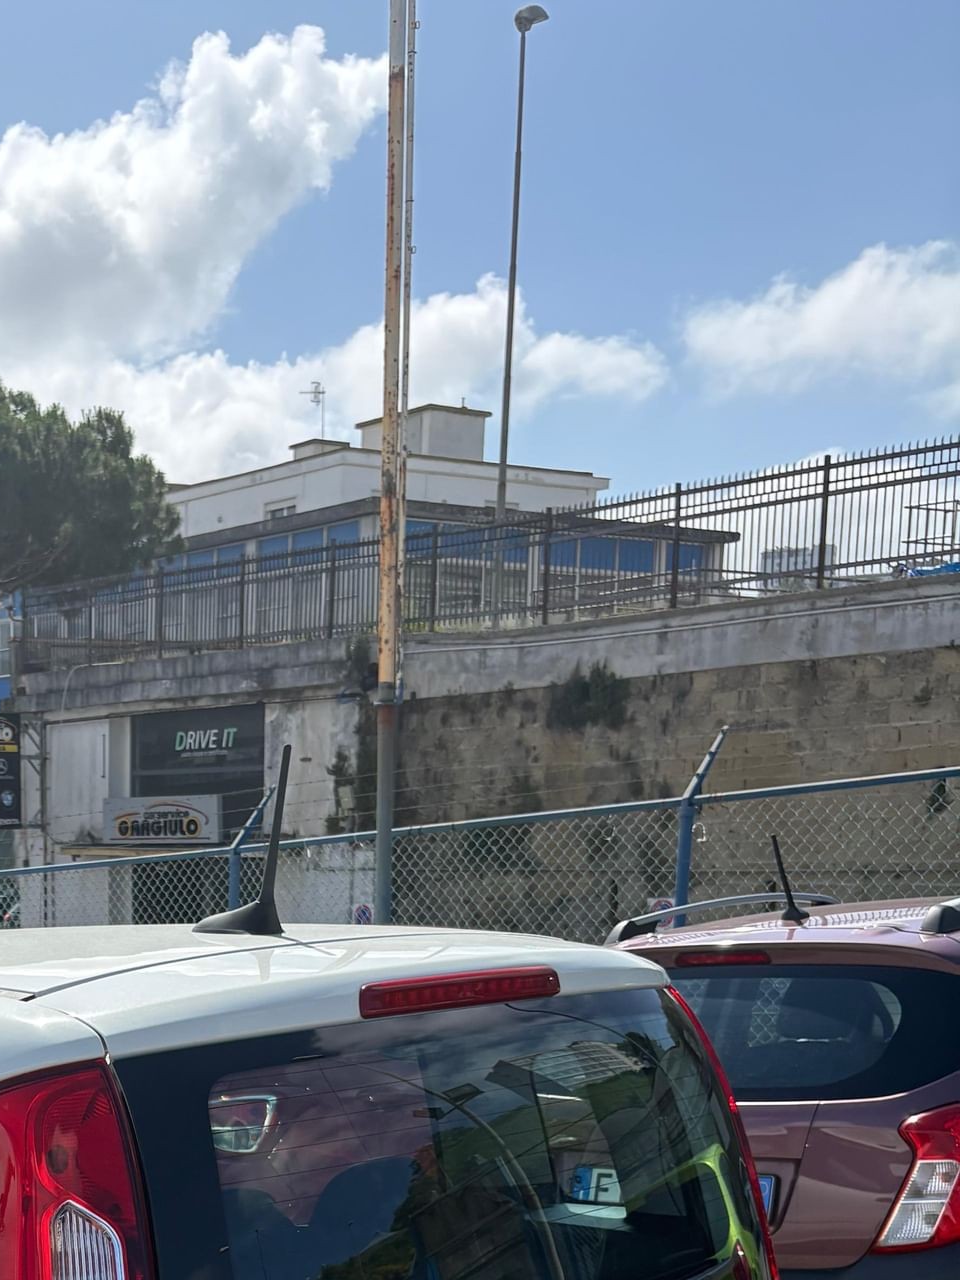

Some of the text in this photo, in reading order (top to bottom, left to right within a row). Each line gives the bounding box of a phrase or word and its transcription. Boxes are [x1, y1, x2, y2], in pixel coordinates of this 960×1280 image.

[175, 728, 238, 751] DRIVE IT
[118, 818, 199, 837] GARGIULO
